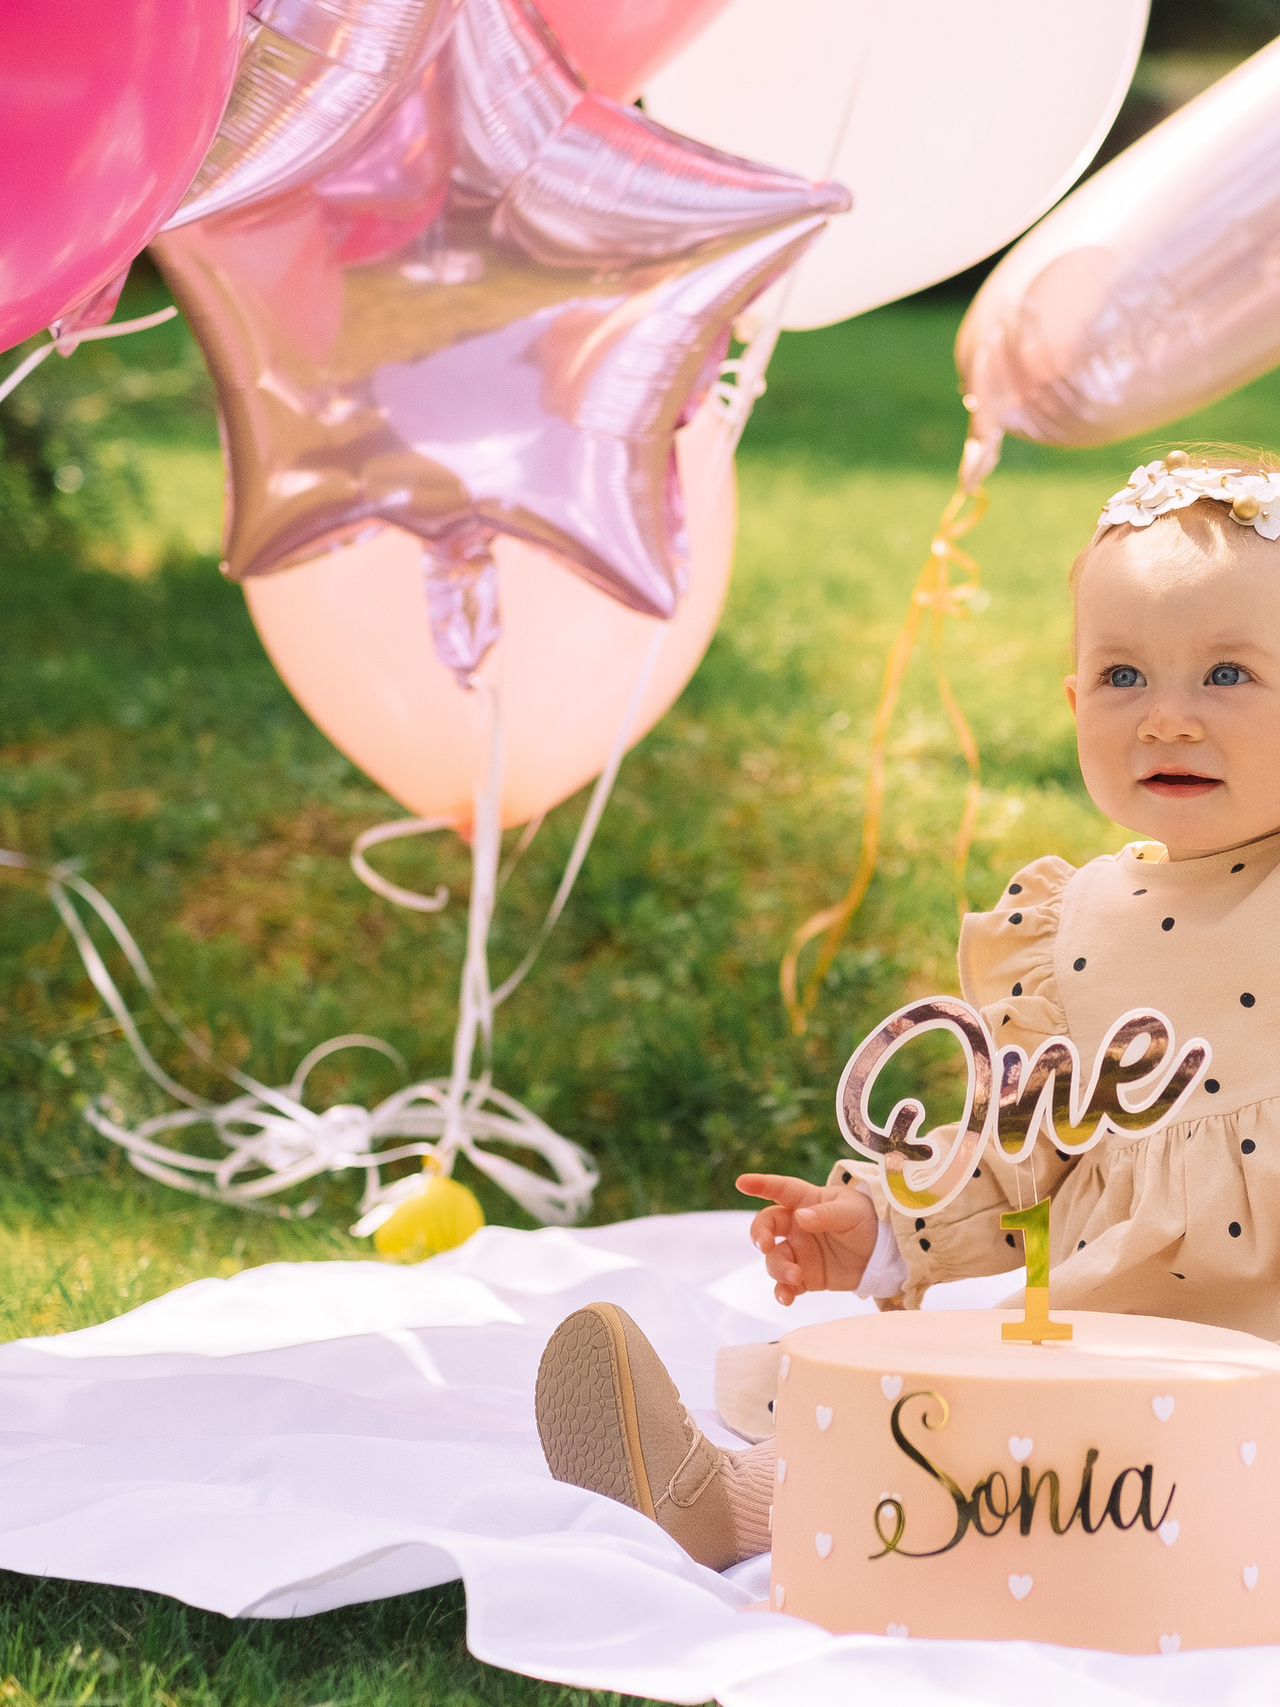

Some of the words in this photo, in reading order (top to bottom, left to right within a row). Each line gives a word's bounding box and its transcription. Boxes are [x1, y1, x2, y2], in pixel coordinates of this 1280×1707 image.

[838, 997, 1211, 1216] One
[1001, 1197, 1073, 1342] 1
[867, 1391, 1176, 1560] Sonia
